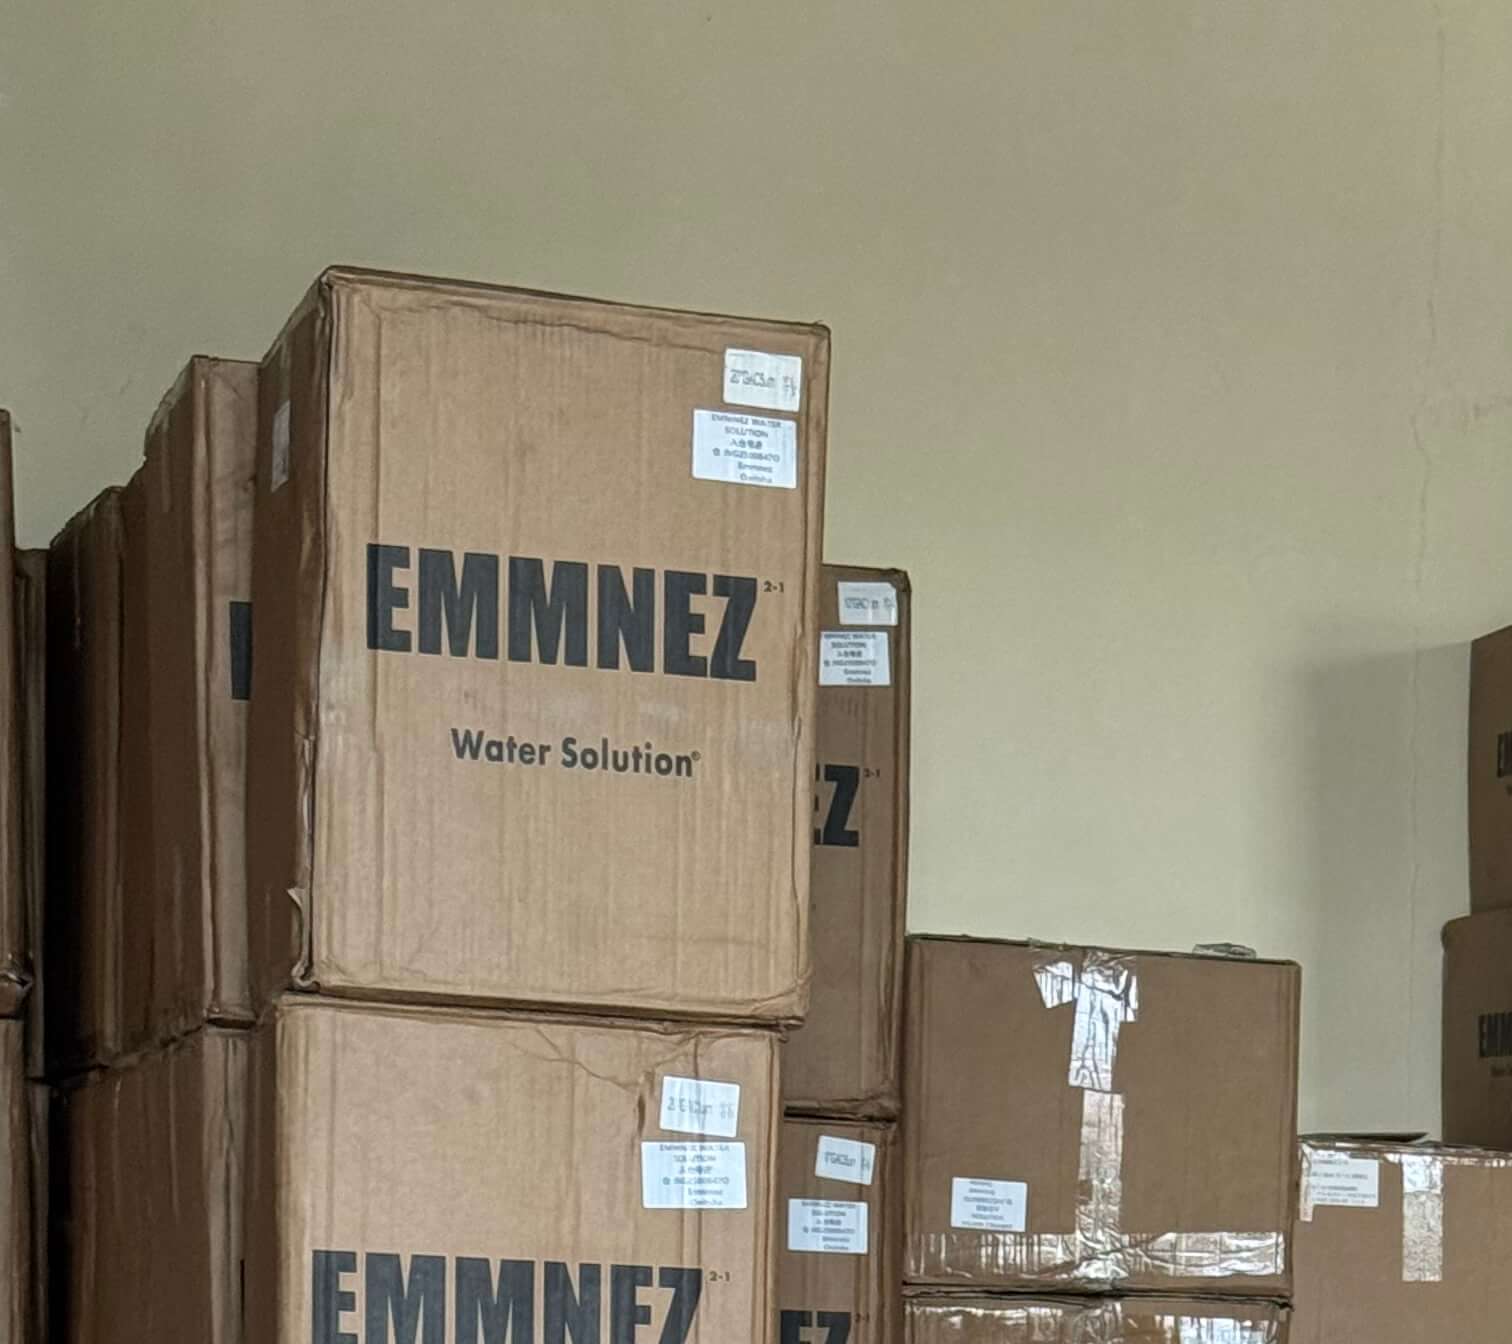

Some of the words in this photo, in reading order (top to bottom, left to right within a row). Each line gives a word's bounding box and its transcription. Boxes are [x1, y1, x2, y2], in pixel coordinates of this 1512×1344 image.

[366, 542, 758, 683] EMMNEZ
[763, 580, 785, 594] 2-1
[450, 728, 552, 766] Water
[708, 1270, 732, 1283] 2-1
